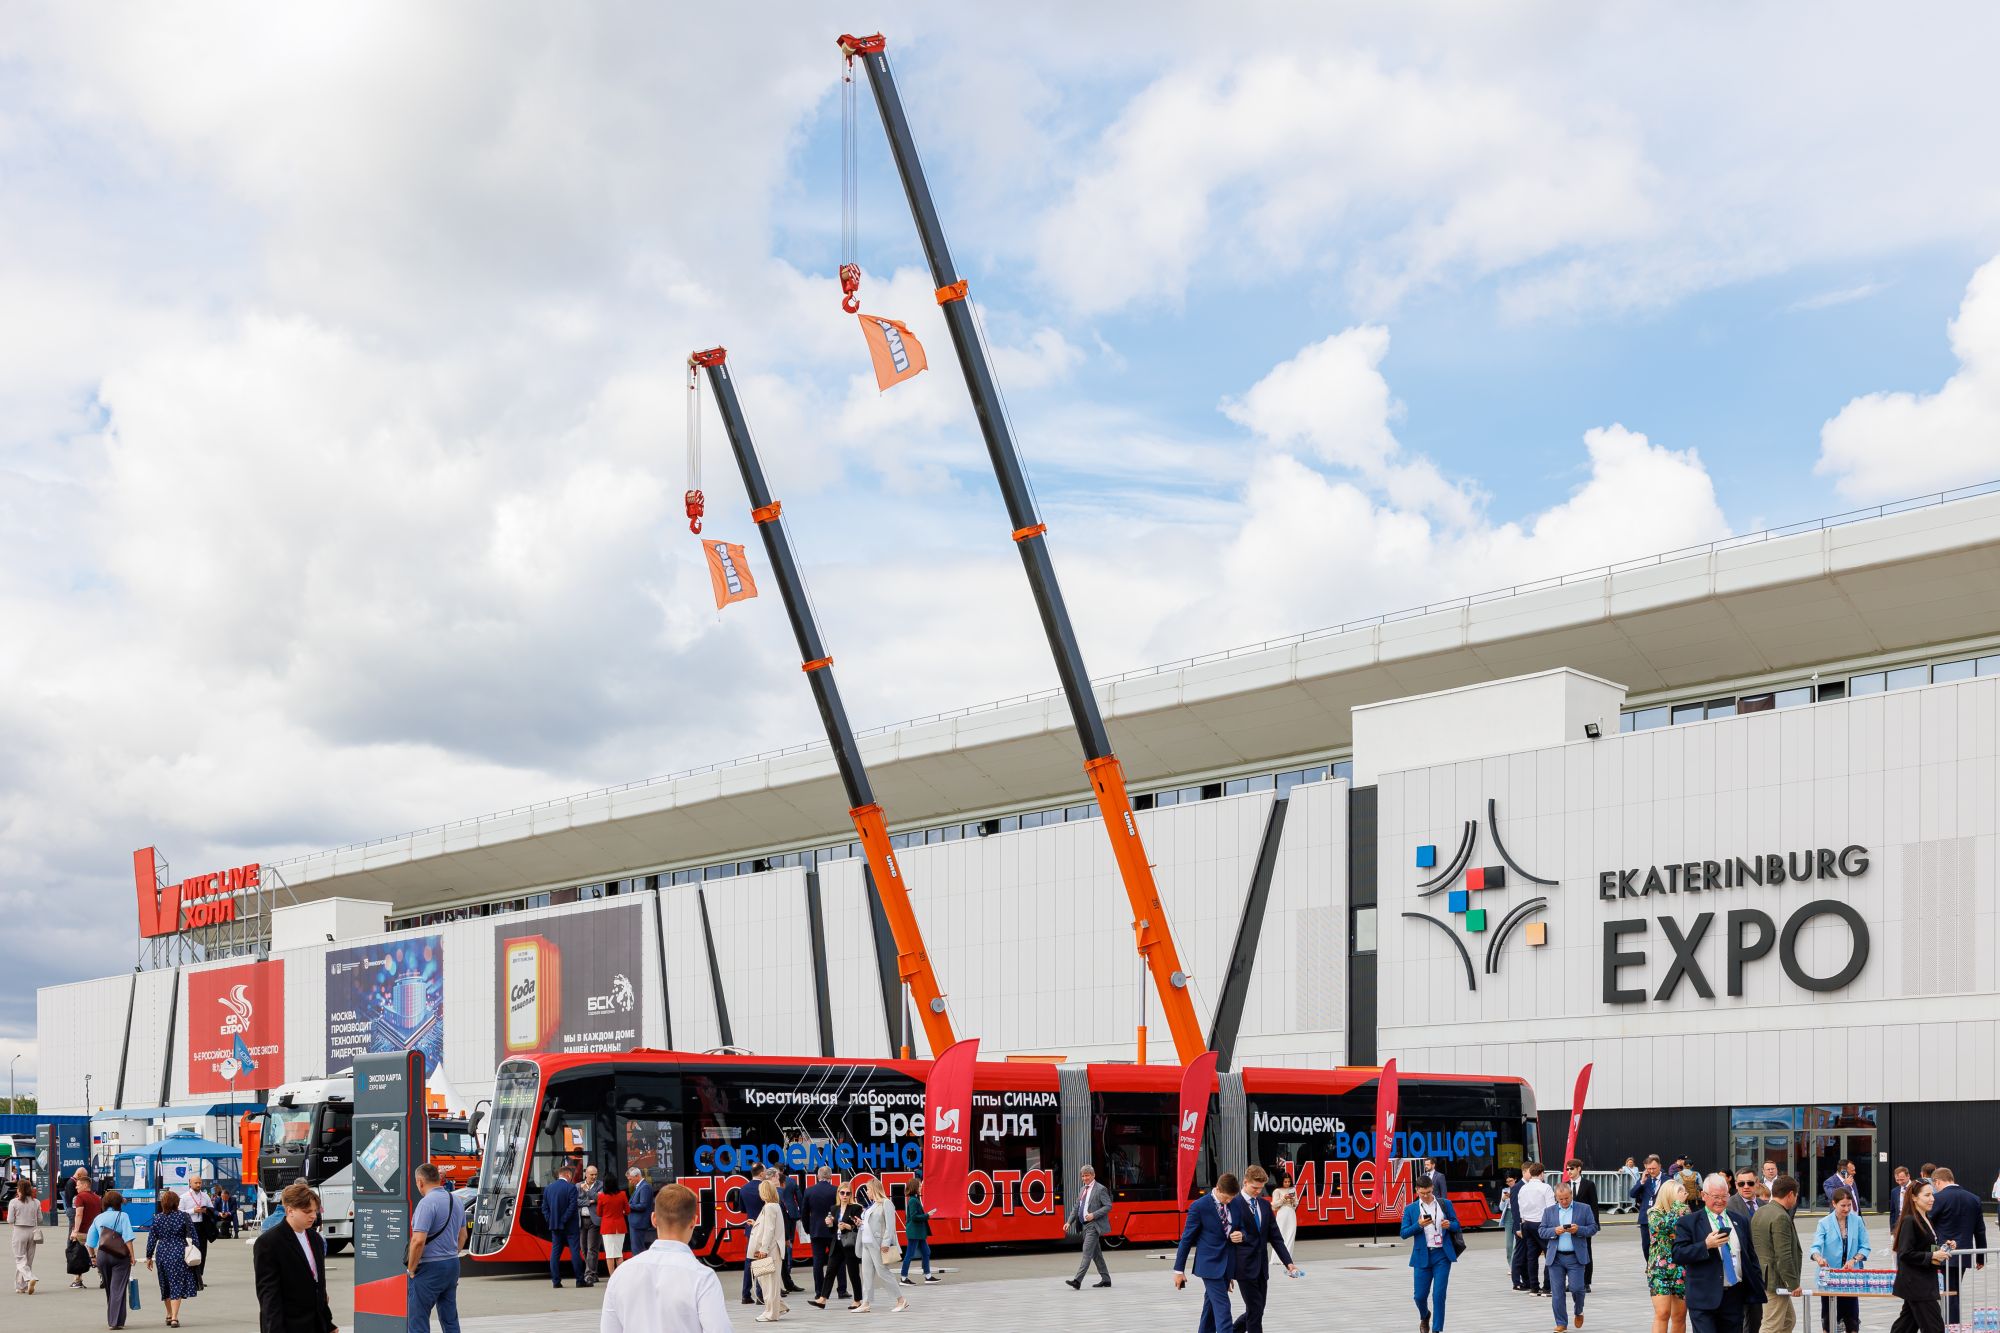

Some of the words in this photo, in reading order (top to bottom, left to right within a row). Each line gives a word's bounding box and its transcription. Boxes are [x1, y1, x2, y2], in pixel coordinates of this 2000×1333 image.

[219, 863, 260, 893] LIVE
[1600, 845, 1870, 900] EKATERINBURG
[182, 897, 235, 930] ХОЛЛ
[1603, 899, 1870, 1003] EXPO
[511, 978, 536, 1002] Сода
[587, 995, 615, 1011] БСК
[331, 1011, 357, 1022] МОСКВА
[220, 1023, 243, 1036] EXPO
[331, 1021, 373, 1034] ПРОИЗВОДИТ
[331, 1033, 372, 1047] ТЕХНОЛОГИИ
[564, 1033, 576, 1043] МЫ
[577, 1033, 582, 1042] В
[583, 1031, 614, 1043] КАЖДОМ
[615, 1029, 635, 1041] ДОМЕ
[260, 1044, 279, 1055] ЭКСПО
[331, 1046, 368, 1059] ЛИДЕРСТВА
[564, 1043, 589, 1054] НАШЕЙ
[590, 1042, 621, 1053] СТРАНЫ!
[368, 1074, 386, 1083] ЭКСПО
[386, 1073, 402, 1082] КАРТА
[745, 1088, 838, 1106] Креативная
[848, 1089, 926, 1108] лаборатор
[972, 1095, 1001, 1106] ппы
[1004, 1092, 1057, 1107] СИНАРА
[869, 1106, 925, 1143] Бре
[980, 1112, 1036, 1142] для
[1253, 1111, 1346, 1135] Молодежь
[932, 1135, 962, 1145] группа
[931, 1143, 963, 1153] синара
[63, 1159, 85, 1167] ДОМА
[693, 1142, 922, 1173] современно
[477, 1215, 489, 1225] 001
